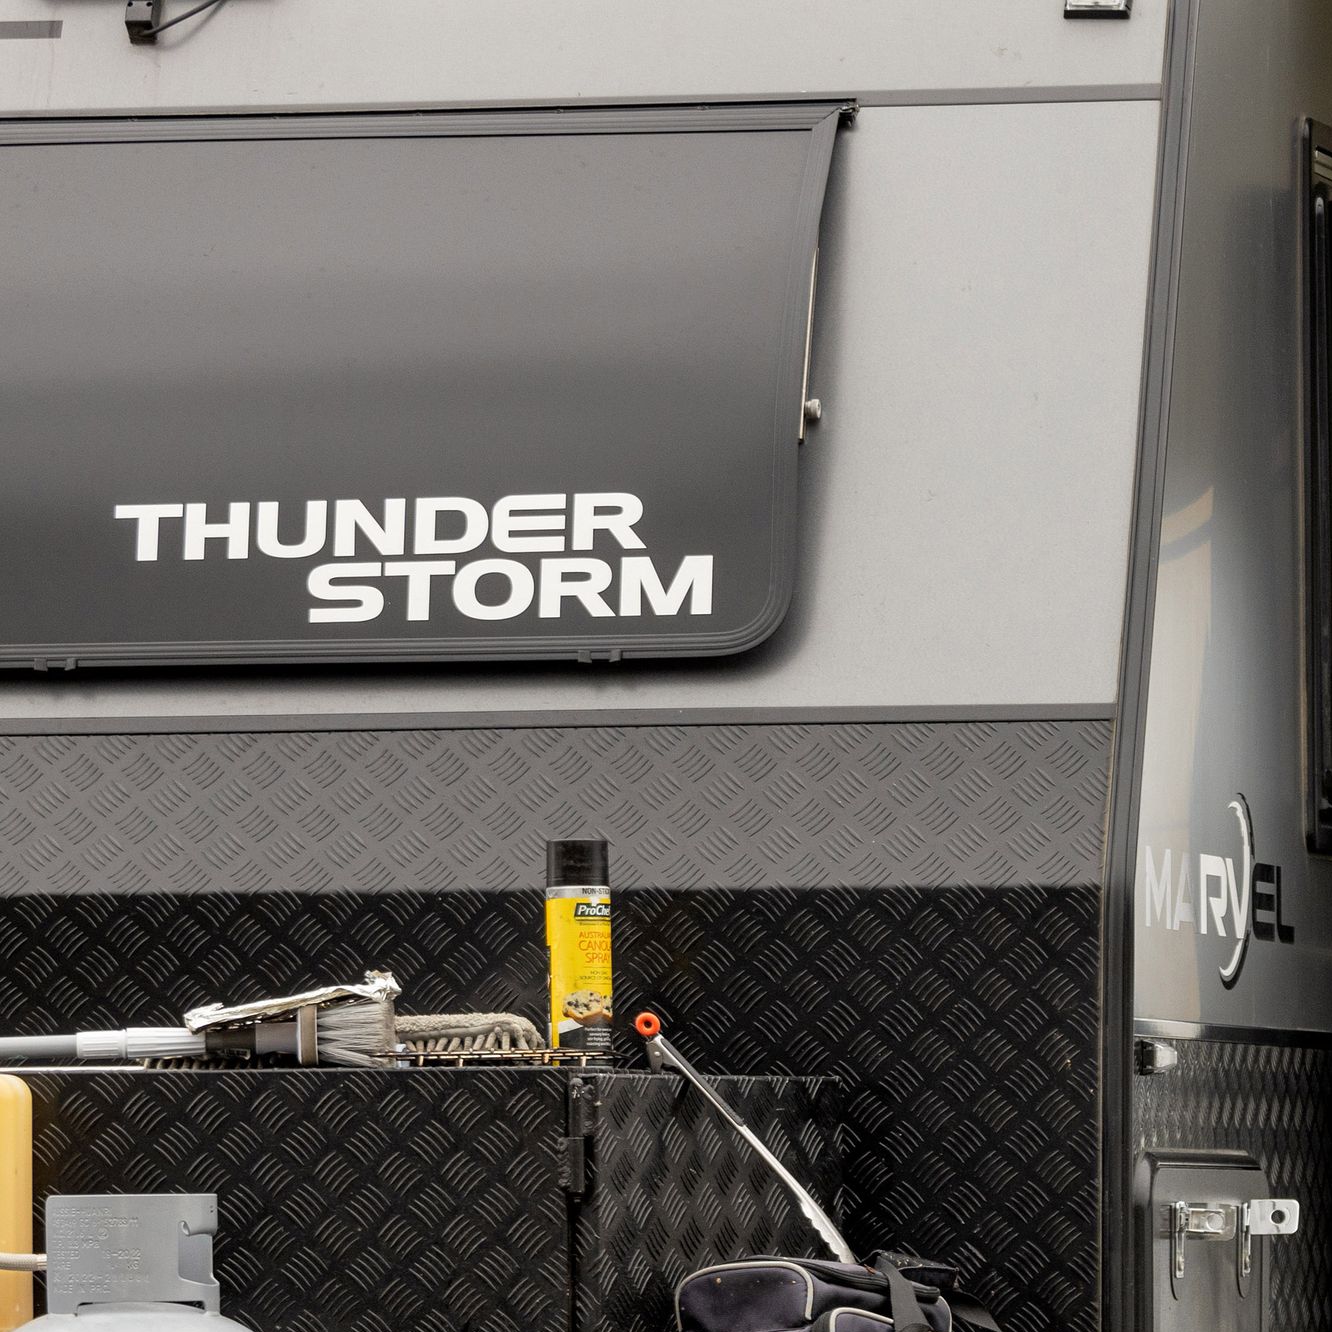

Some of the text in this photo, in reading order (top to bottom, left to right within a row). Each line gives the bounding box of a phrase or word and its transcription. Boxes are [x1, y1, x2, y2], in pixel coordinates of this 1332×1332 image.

[114, 492, 646, 561] THUNDER
[307, 555, 713, 624] STORM
[1145, 838, 1295, 952] MARVEL
[578, 940, 611, 951] CANOL
